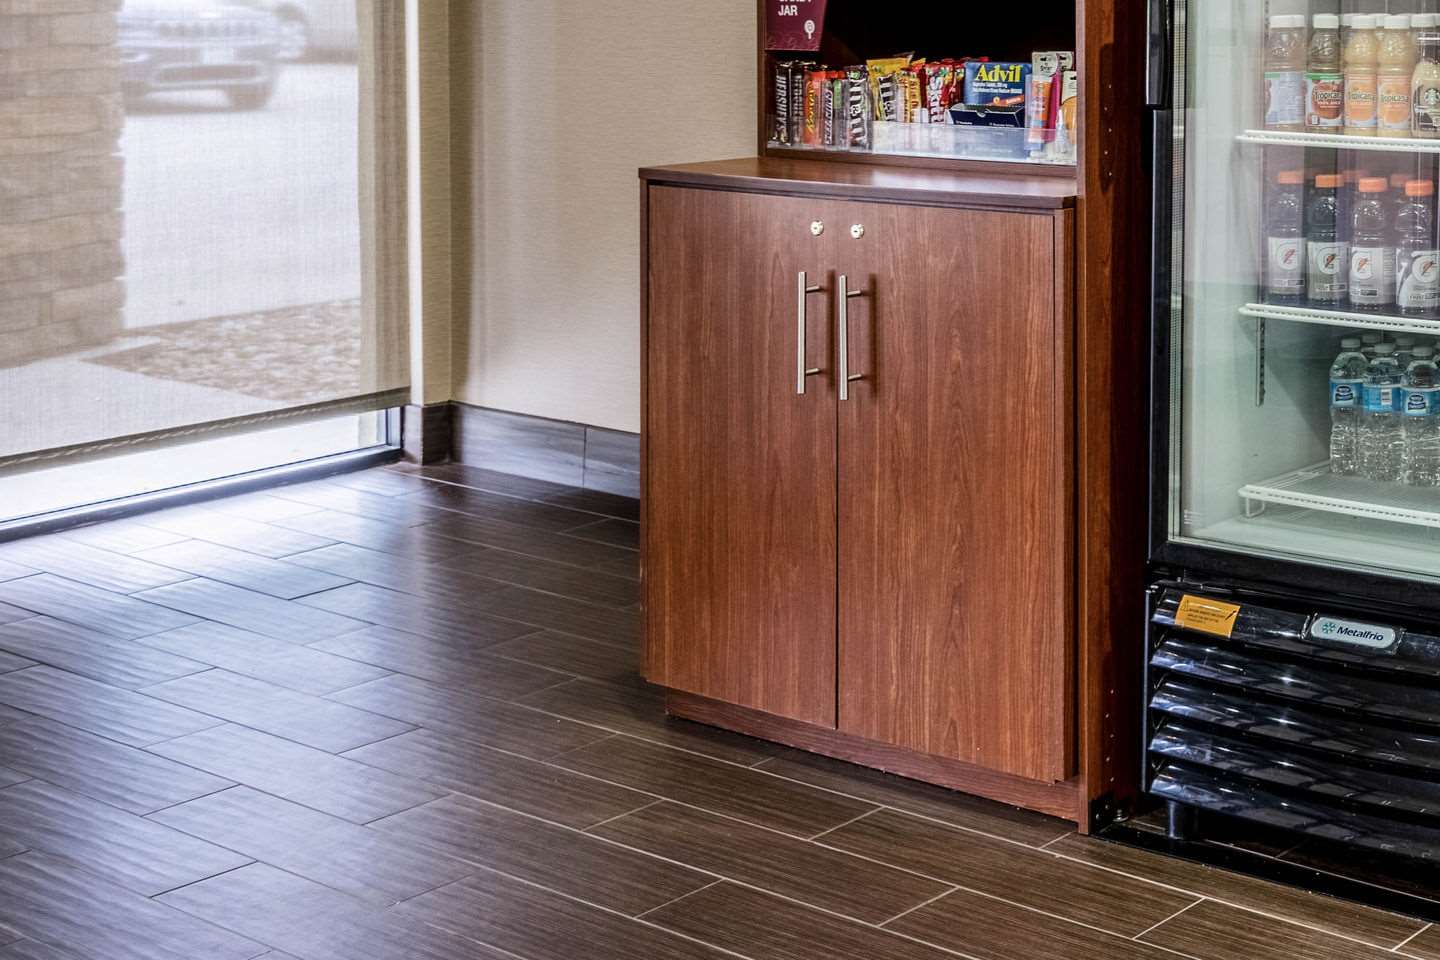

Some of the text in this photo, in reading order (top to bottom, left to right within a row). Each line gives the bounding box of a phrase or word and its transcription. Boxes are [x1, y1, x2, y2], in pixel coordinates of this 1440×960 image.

[778, 5, 798, 16] JAR
[975, 64, 1024, 83] Advil
[1336, 625, 1385, 642] Metalfrio
